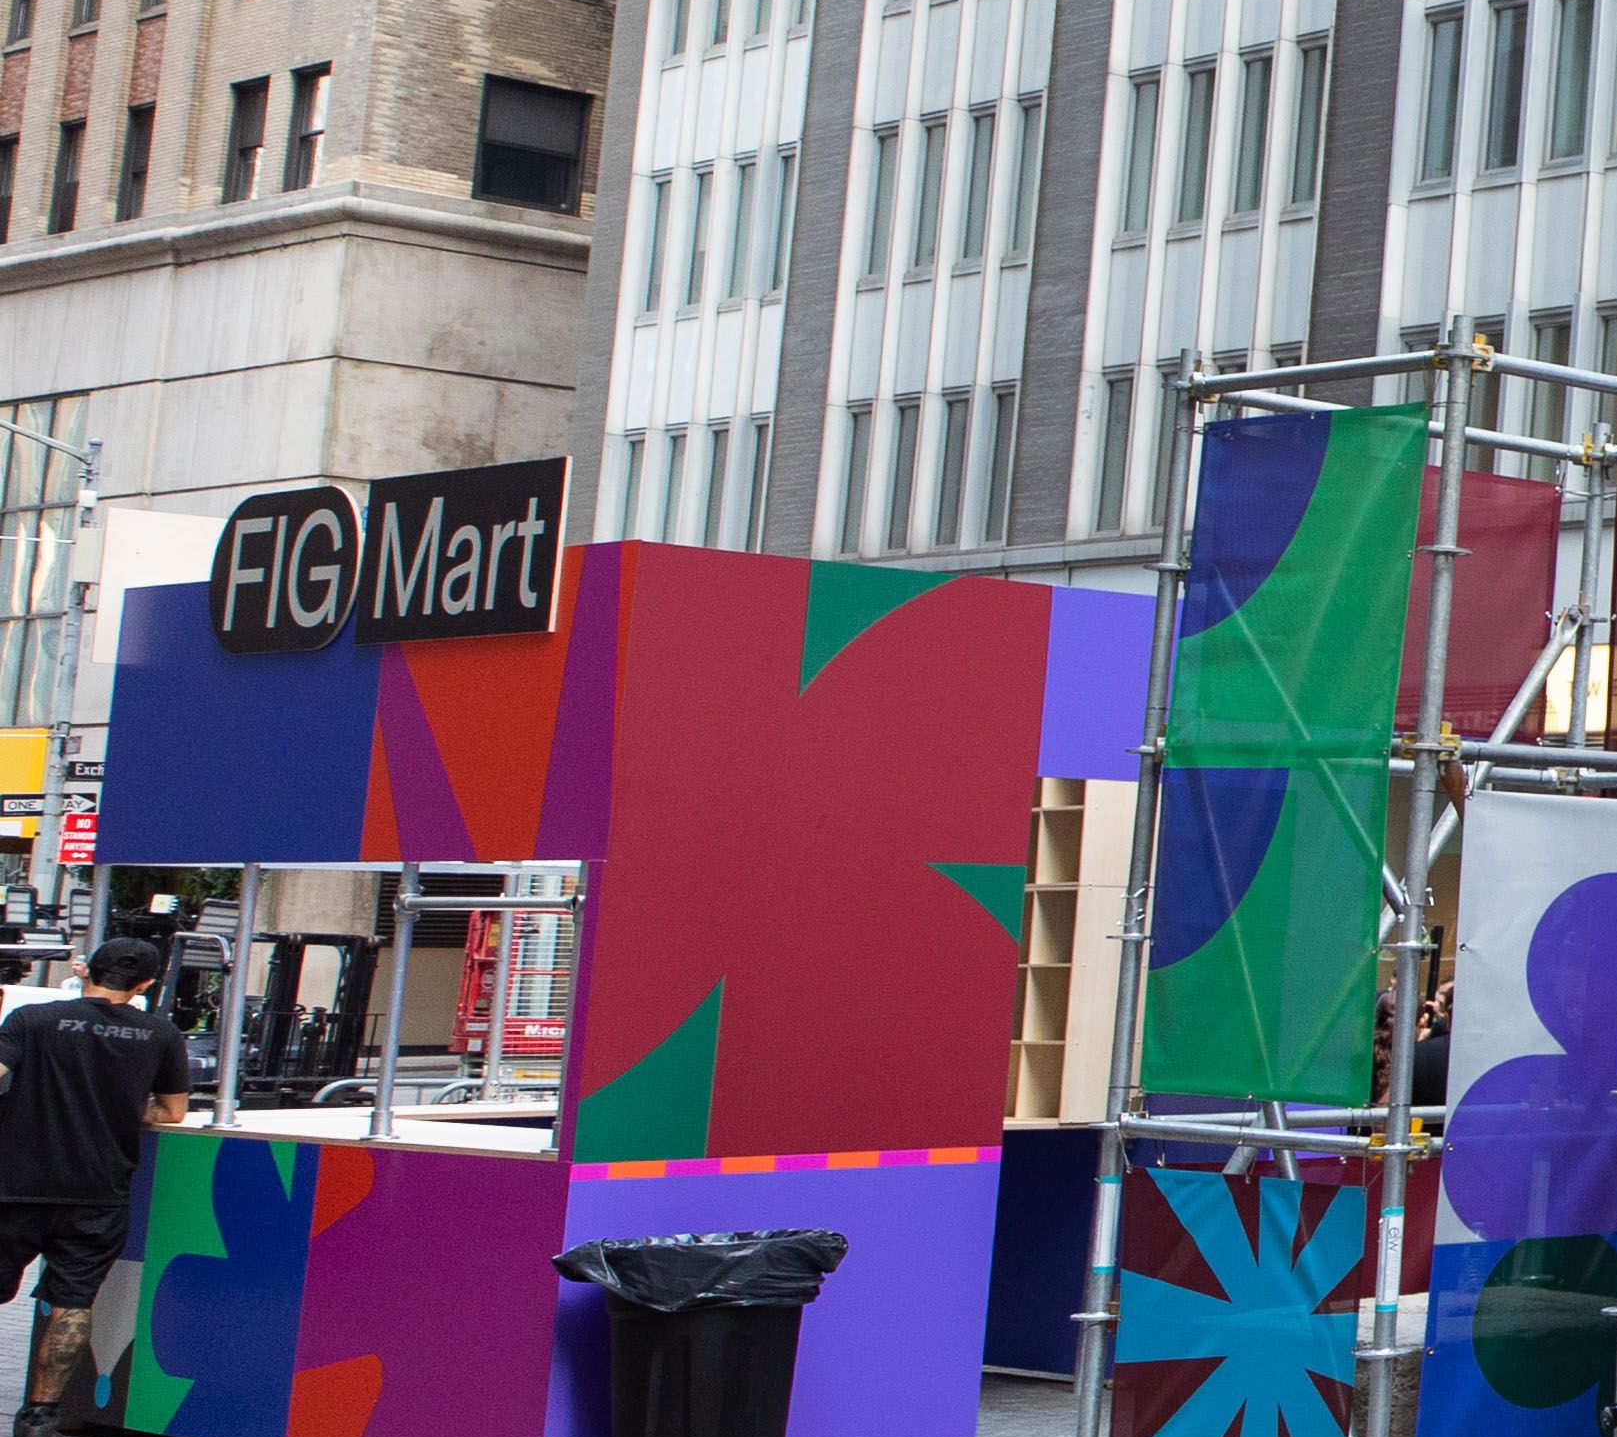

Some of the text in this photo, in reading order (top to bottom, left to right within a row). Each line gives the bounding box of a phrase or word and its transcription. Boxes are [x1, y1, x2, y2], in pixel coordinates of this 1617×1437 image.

[222, 496, 546, 632] FIG Mart
[8, 799, 84, 810] ONE AY
[76, 818, 92, 829] NO
[57, 1019, 152, 1041] FX CREW
